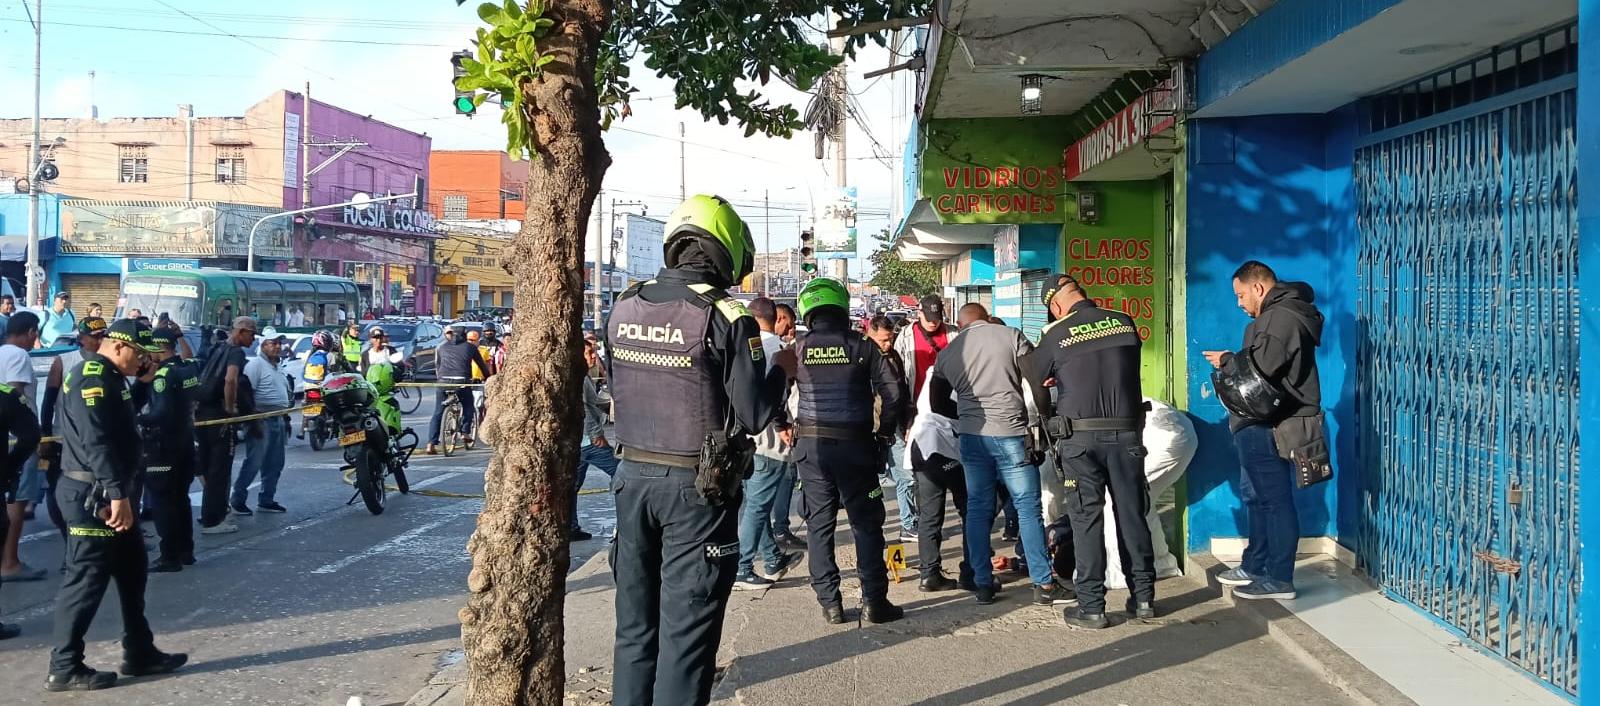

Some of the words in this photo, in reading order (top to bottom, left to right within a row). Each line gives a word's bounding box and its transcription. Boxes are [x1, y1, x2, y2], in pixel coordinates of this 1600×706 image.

[1078, 121, 1113, 173] VIDRIOS
[1114, 110, 1129, 153] LA
[943, 165, 1059, 190] VIDRIOS
[936, 193, 1056, 214] CARTONES
[107, 213, 162, 229] ANITA
[343, 203, 387, 228] FUCSIA
[1068, 237, 1152, 261] CLAROS
[1067, 265, 1153, 287] COLORES
[617, 322, 685, 345] POLICÍA
[1069, 316, 1122, 336] POLICÍA
[893, 549, 903, 564] 4
